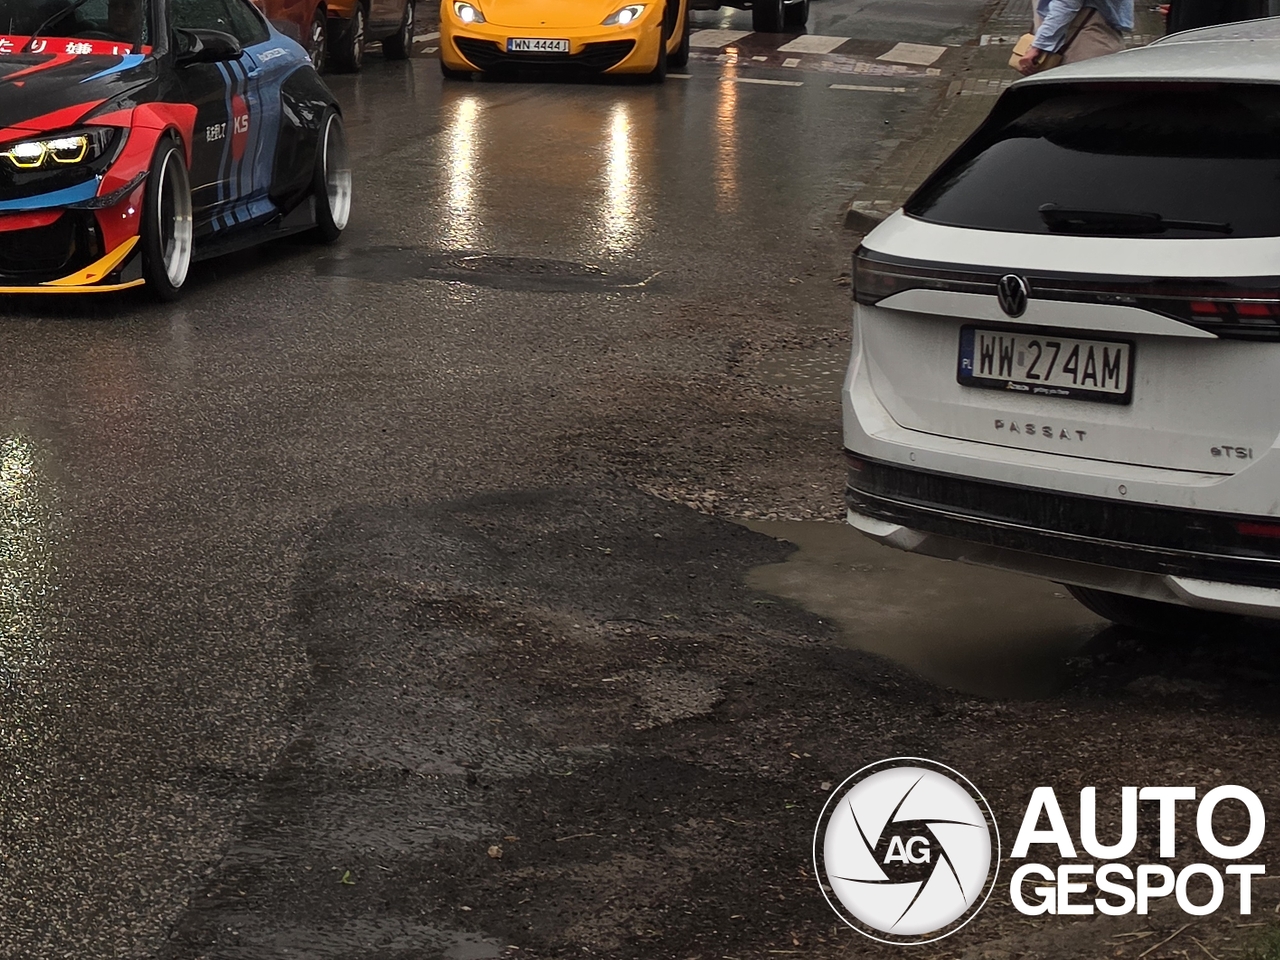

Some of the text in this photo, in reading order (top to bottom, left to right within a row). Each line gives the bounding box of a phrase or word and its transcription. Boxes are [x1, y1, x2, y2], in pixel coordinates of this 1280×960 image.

[514, 40, 531, 50] WN
[962, 358, 973, 370] PL
[980, 334, 1122, 390] WW 274AM
[994, 419, 1087, 441] PASSAT
[1210, 445, 1253, 459] eTSI
